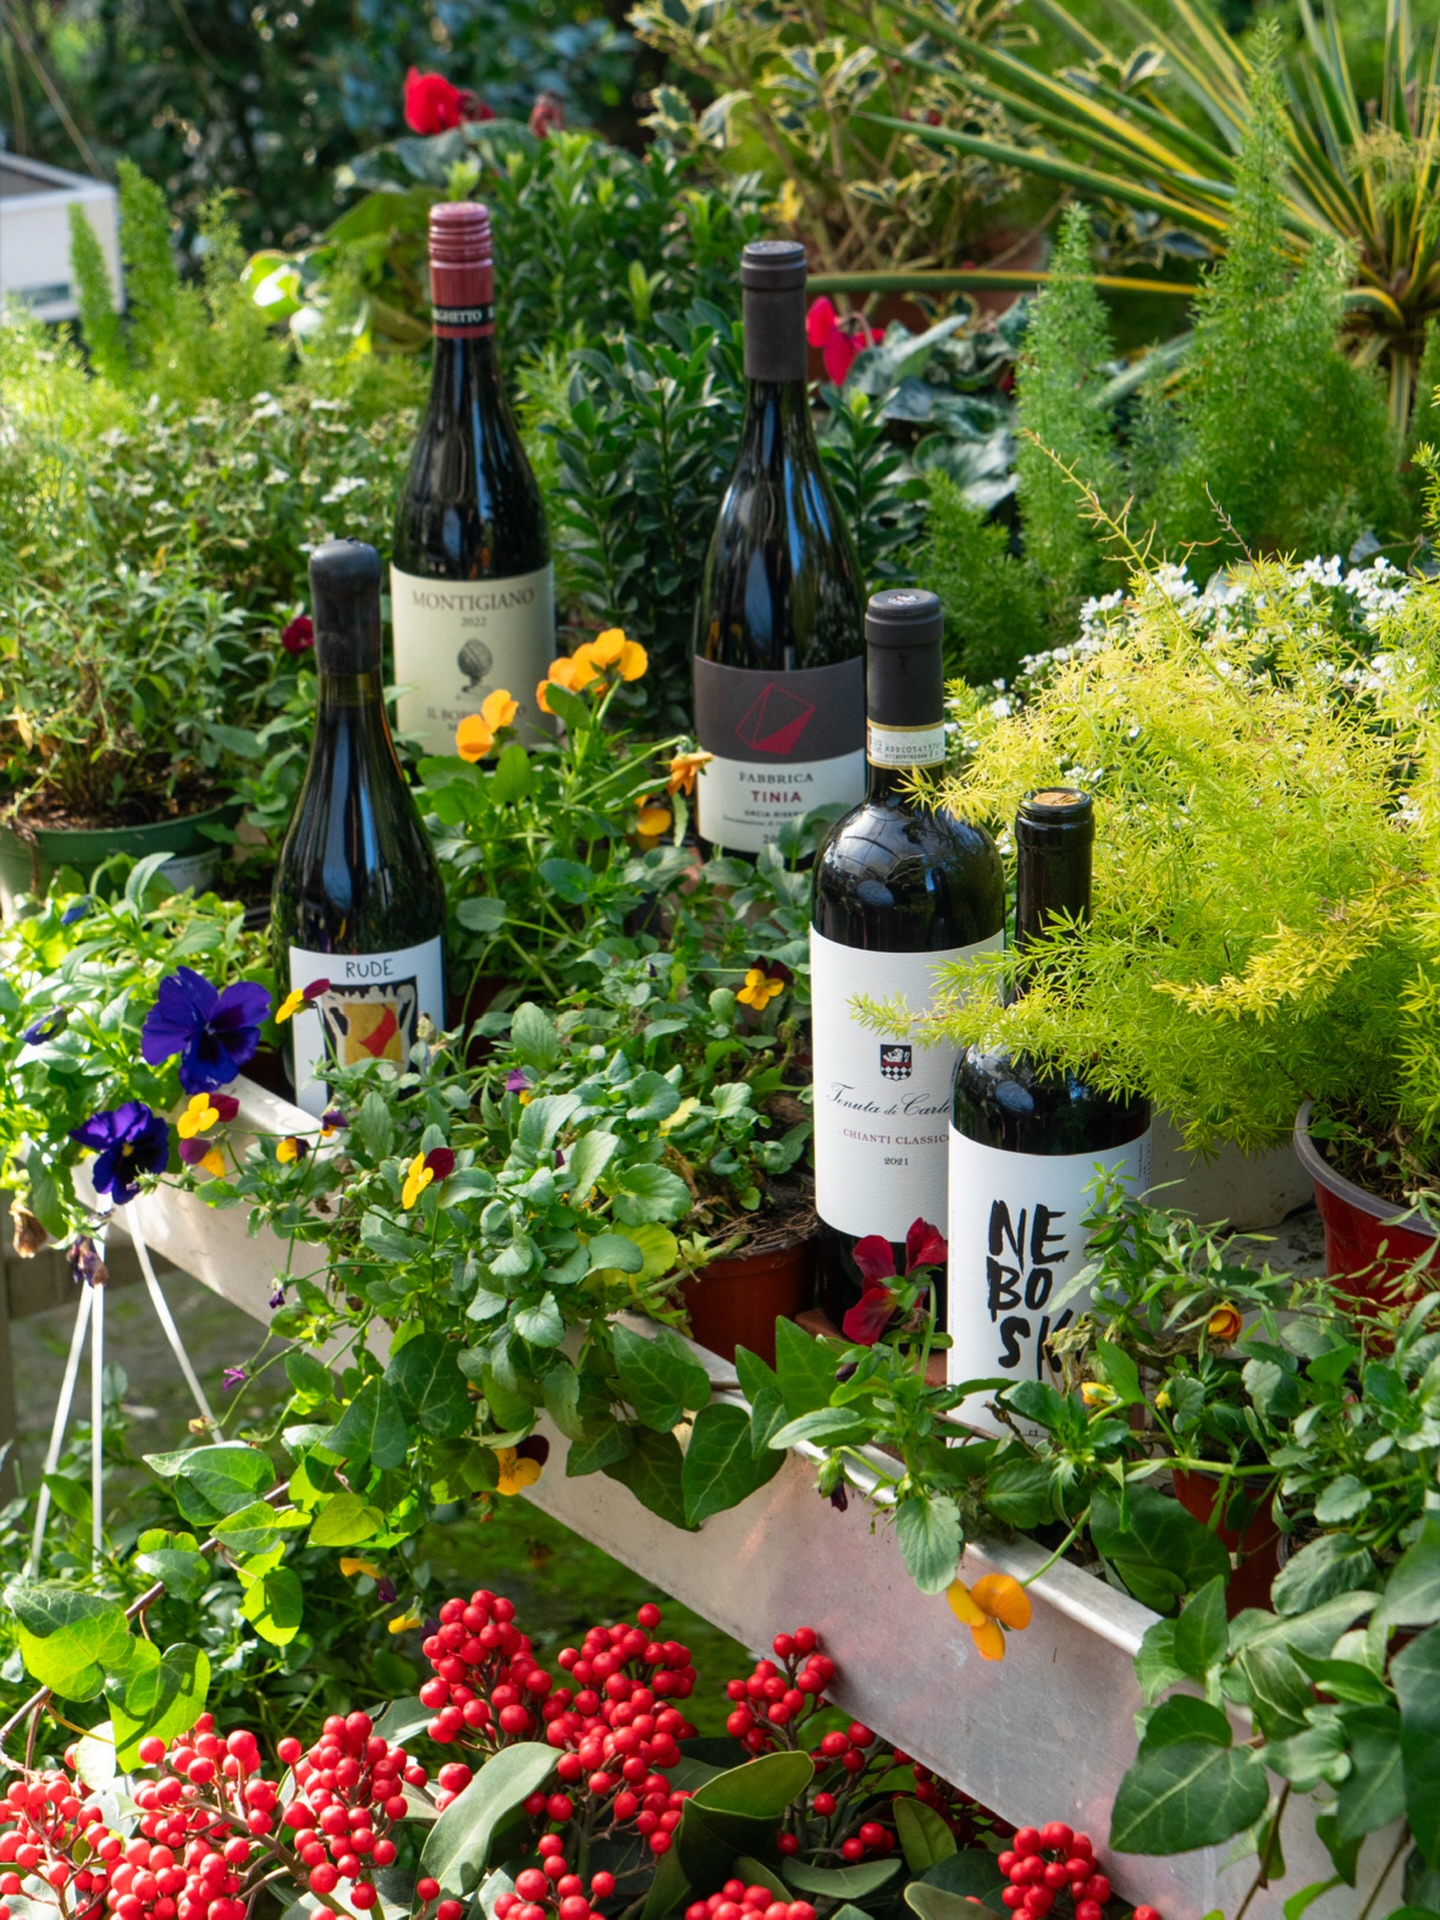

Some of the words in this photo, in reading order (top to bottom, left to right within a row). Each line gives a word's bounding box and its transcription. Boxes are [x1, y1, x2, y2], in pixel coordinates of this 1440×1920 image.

[412, 587, 535, 611] MONTIGIANO
[460, 616, 486, 628] 2022
[739, 771, 814, 784] FABBRICA
[751, 790, 802, 803] TINIA
[763, 834, 778, 845] 20
[345, 958, 394, 978] RUDE
[826, 1081, 881, 1113] Tenuta
[883, 1103, 899, 1116] di
[900, 1092, 951, 1116] Carle
[843, 1128, 891, 1144] CHIANTI
[895, 1133, 949, 1145] CLASSIC
[883, 1157, 909, 1166] 2021
[988, 1199, 1071, 1275] NE
[986, 1255, 1054, 1323] BO
[997, 1308, 1076, 1381] SK
